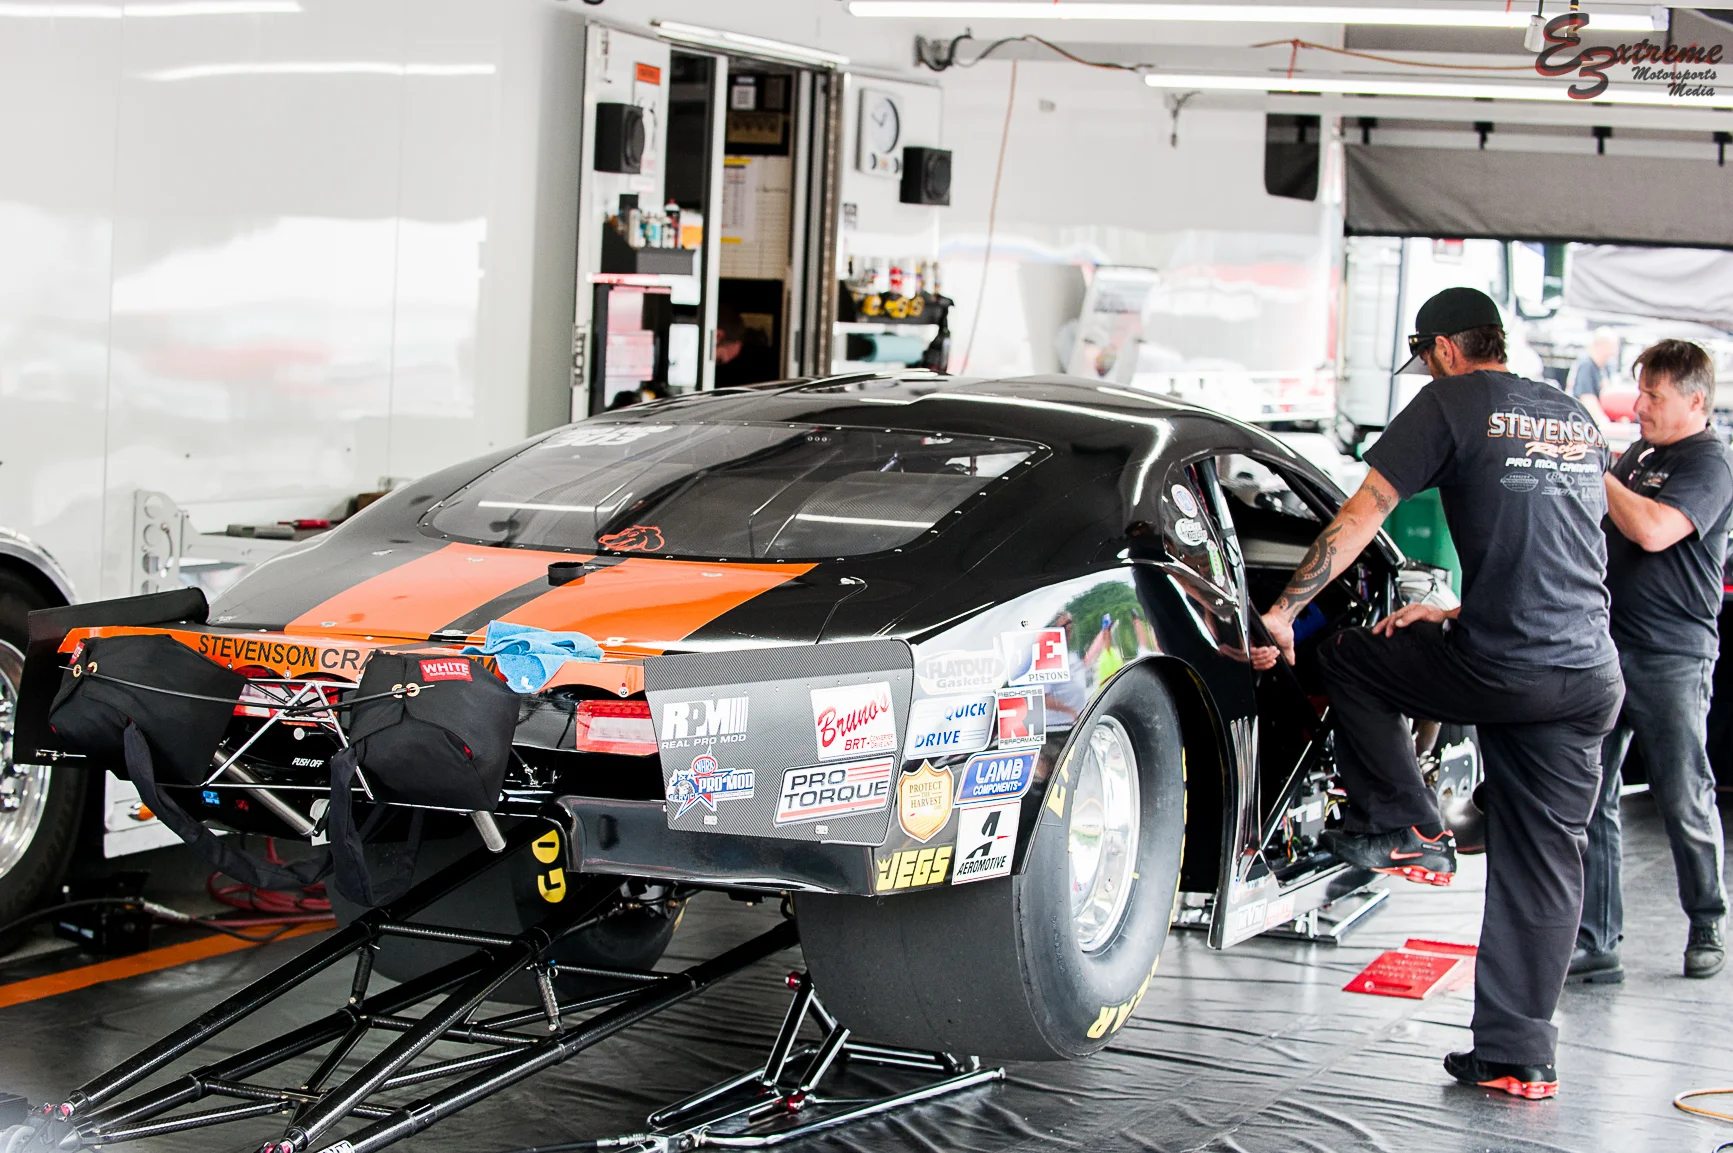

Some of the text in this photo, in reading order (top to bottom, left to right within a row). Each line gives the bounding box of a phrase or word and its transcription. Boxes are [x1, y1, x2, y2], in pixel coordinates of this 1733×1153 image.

[1525, 440, 1597, 461] Racing
[1505, 457, 1533, 468] PRO
[198, 634, 317, 668] STEVENSON
[422, 662, 470, 674] WHITE
[927, 658, 995, 682] FLATOUT
[1028, 671, 1070, 682] PISTONS
[936, 675, 993, 688] Gaskets
[997, 688, 1044, 698] REDHORSE
[661, 697, 749, 740] RPM
[817, 691, 890, 748] Bruno's
[944, 702, 988, 721] QUICK
[661, 734, 747, 750] REAL PRO MOD
[914, 730, 962, 749] DRIVE
[999, 736, 1045, 746] PERFORMANCE
[291, 757, 325, 768] PUSH OFF
[695, 759, 716, 775] NHRA
[975, 757, 1024, 784] LAMB
[700, 775, 722, 794] PRO
[725, 771, 755, 793] MOD
[790, 769, 847, 791] PRO
[909, 780, 943, 794] PROTECT
[972, 781, 1018, 796] COMPONENTS
[784, 780, 889, 809] TORQUE
[910, 795, 943, 809] HARVEST
[875, 845, 953, 892] JEGS
[956, 855, 1008, 877] AEROMOTIVE
